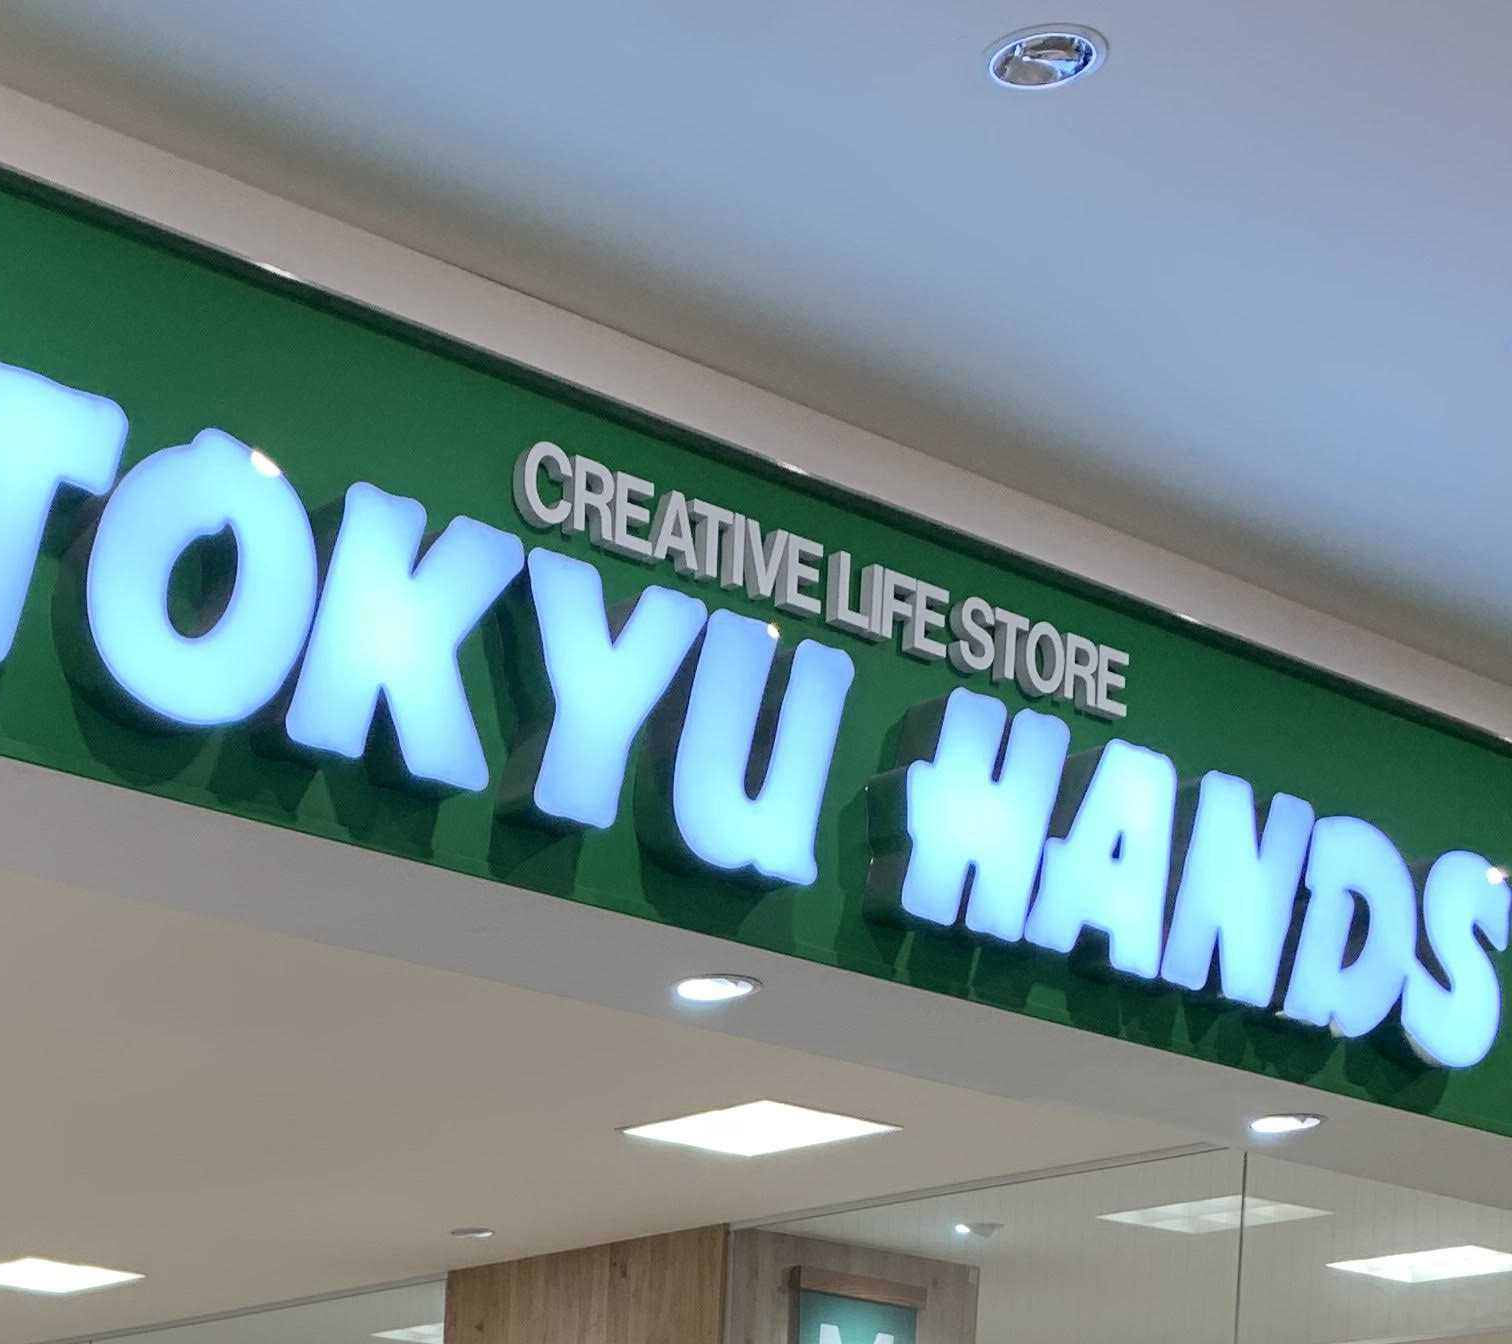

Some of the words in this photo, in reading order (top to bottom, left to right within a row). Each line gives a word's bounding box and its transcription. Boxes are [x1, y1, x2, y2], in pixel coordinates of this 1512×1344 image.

[513, 441, 824, 617] CREATIVE
[826, 551, 949, 660] LIFE
[948, 597, 1129, 720] STORE
[901, 687, 1511, 1069] HANDS
